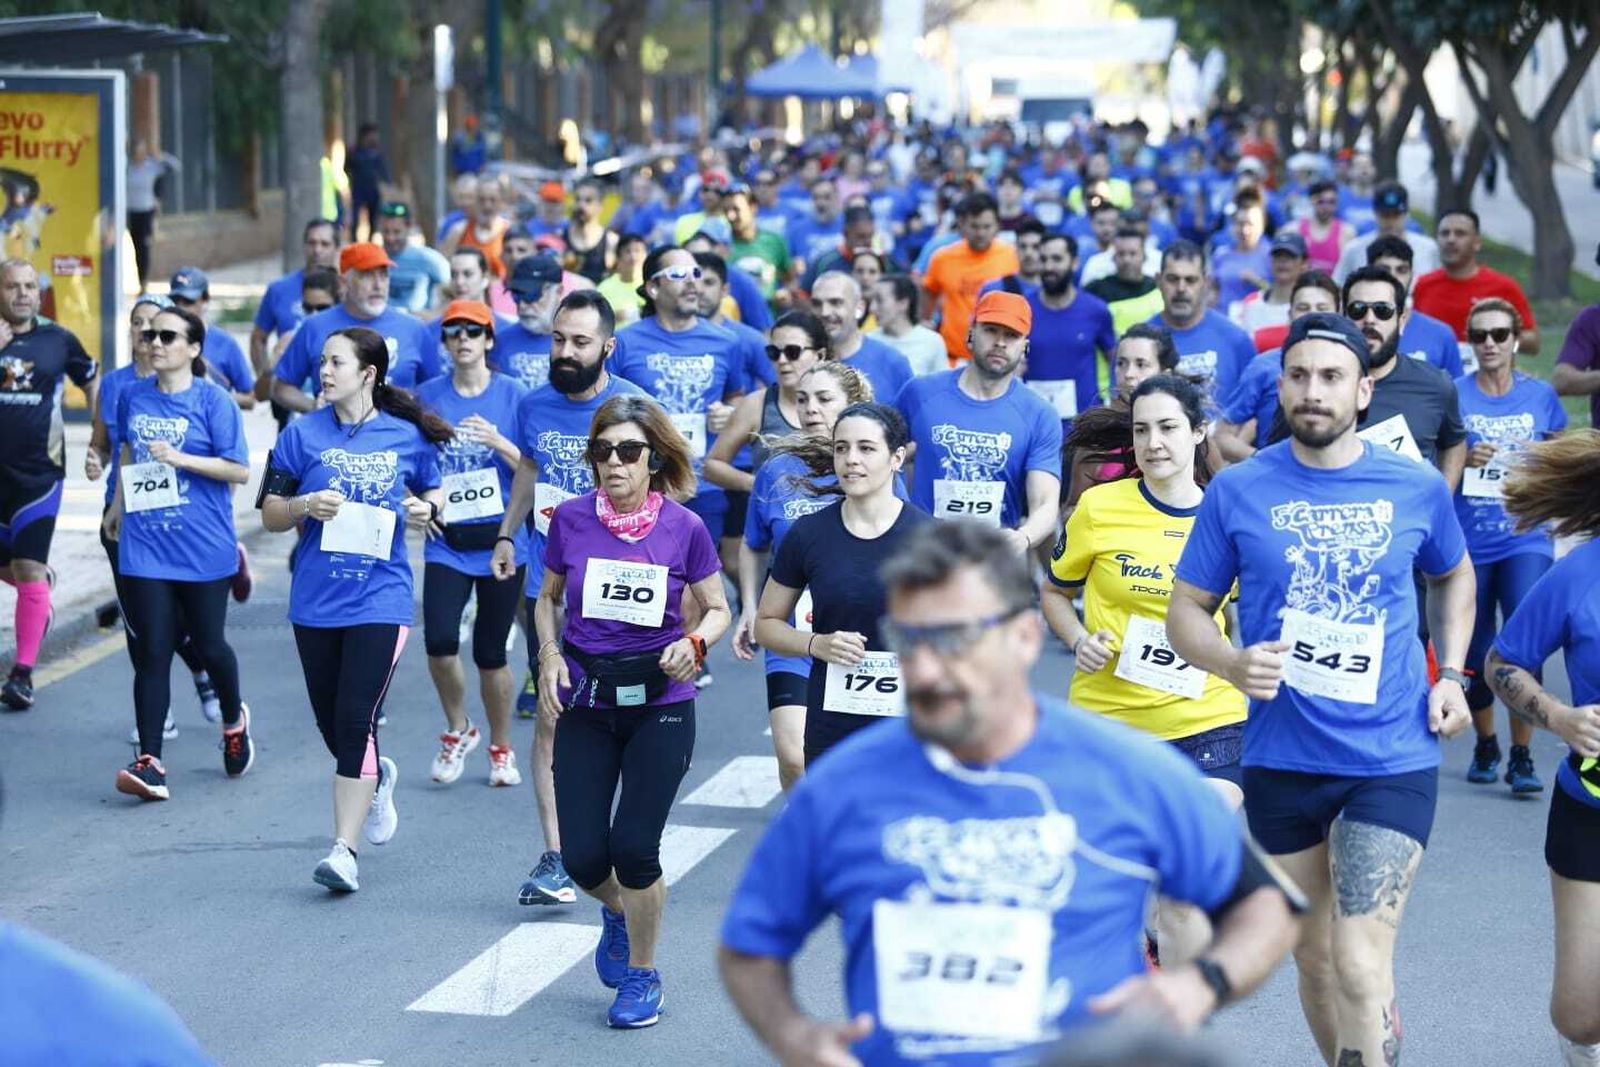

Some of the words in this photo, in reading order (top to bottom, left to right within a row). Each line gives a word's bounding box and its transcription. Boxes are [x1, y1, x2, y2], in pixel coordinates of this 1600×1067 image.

[1479, 468, 1509, 481] 15
[133, 478, 170, 494] 704
[448, 486, 495, 503] 600
[946, 500, 993, 514] 219
[1115, 554, 1164, 581] Track
[601, 583, 655, 604] 130
[1292, 640, 1371, 673] 543
[844, 673, 899, 694] 176
[898, 951, 1025, 986] 382
